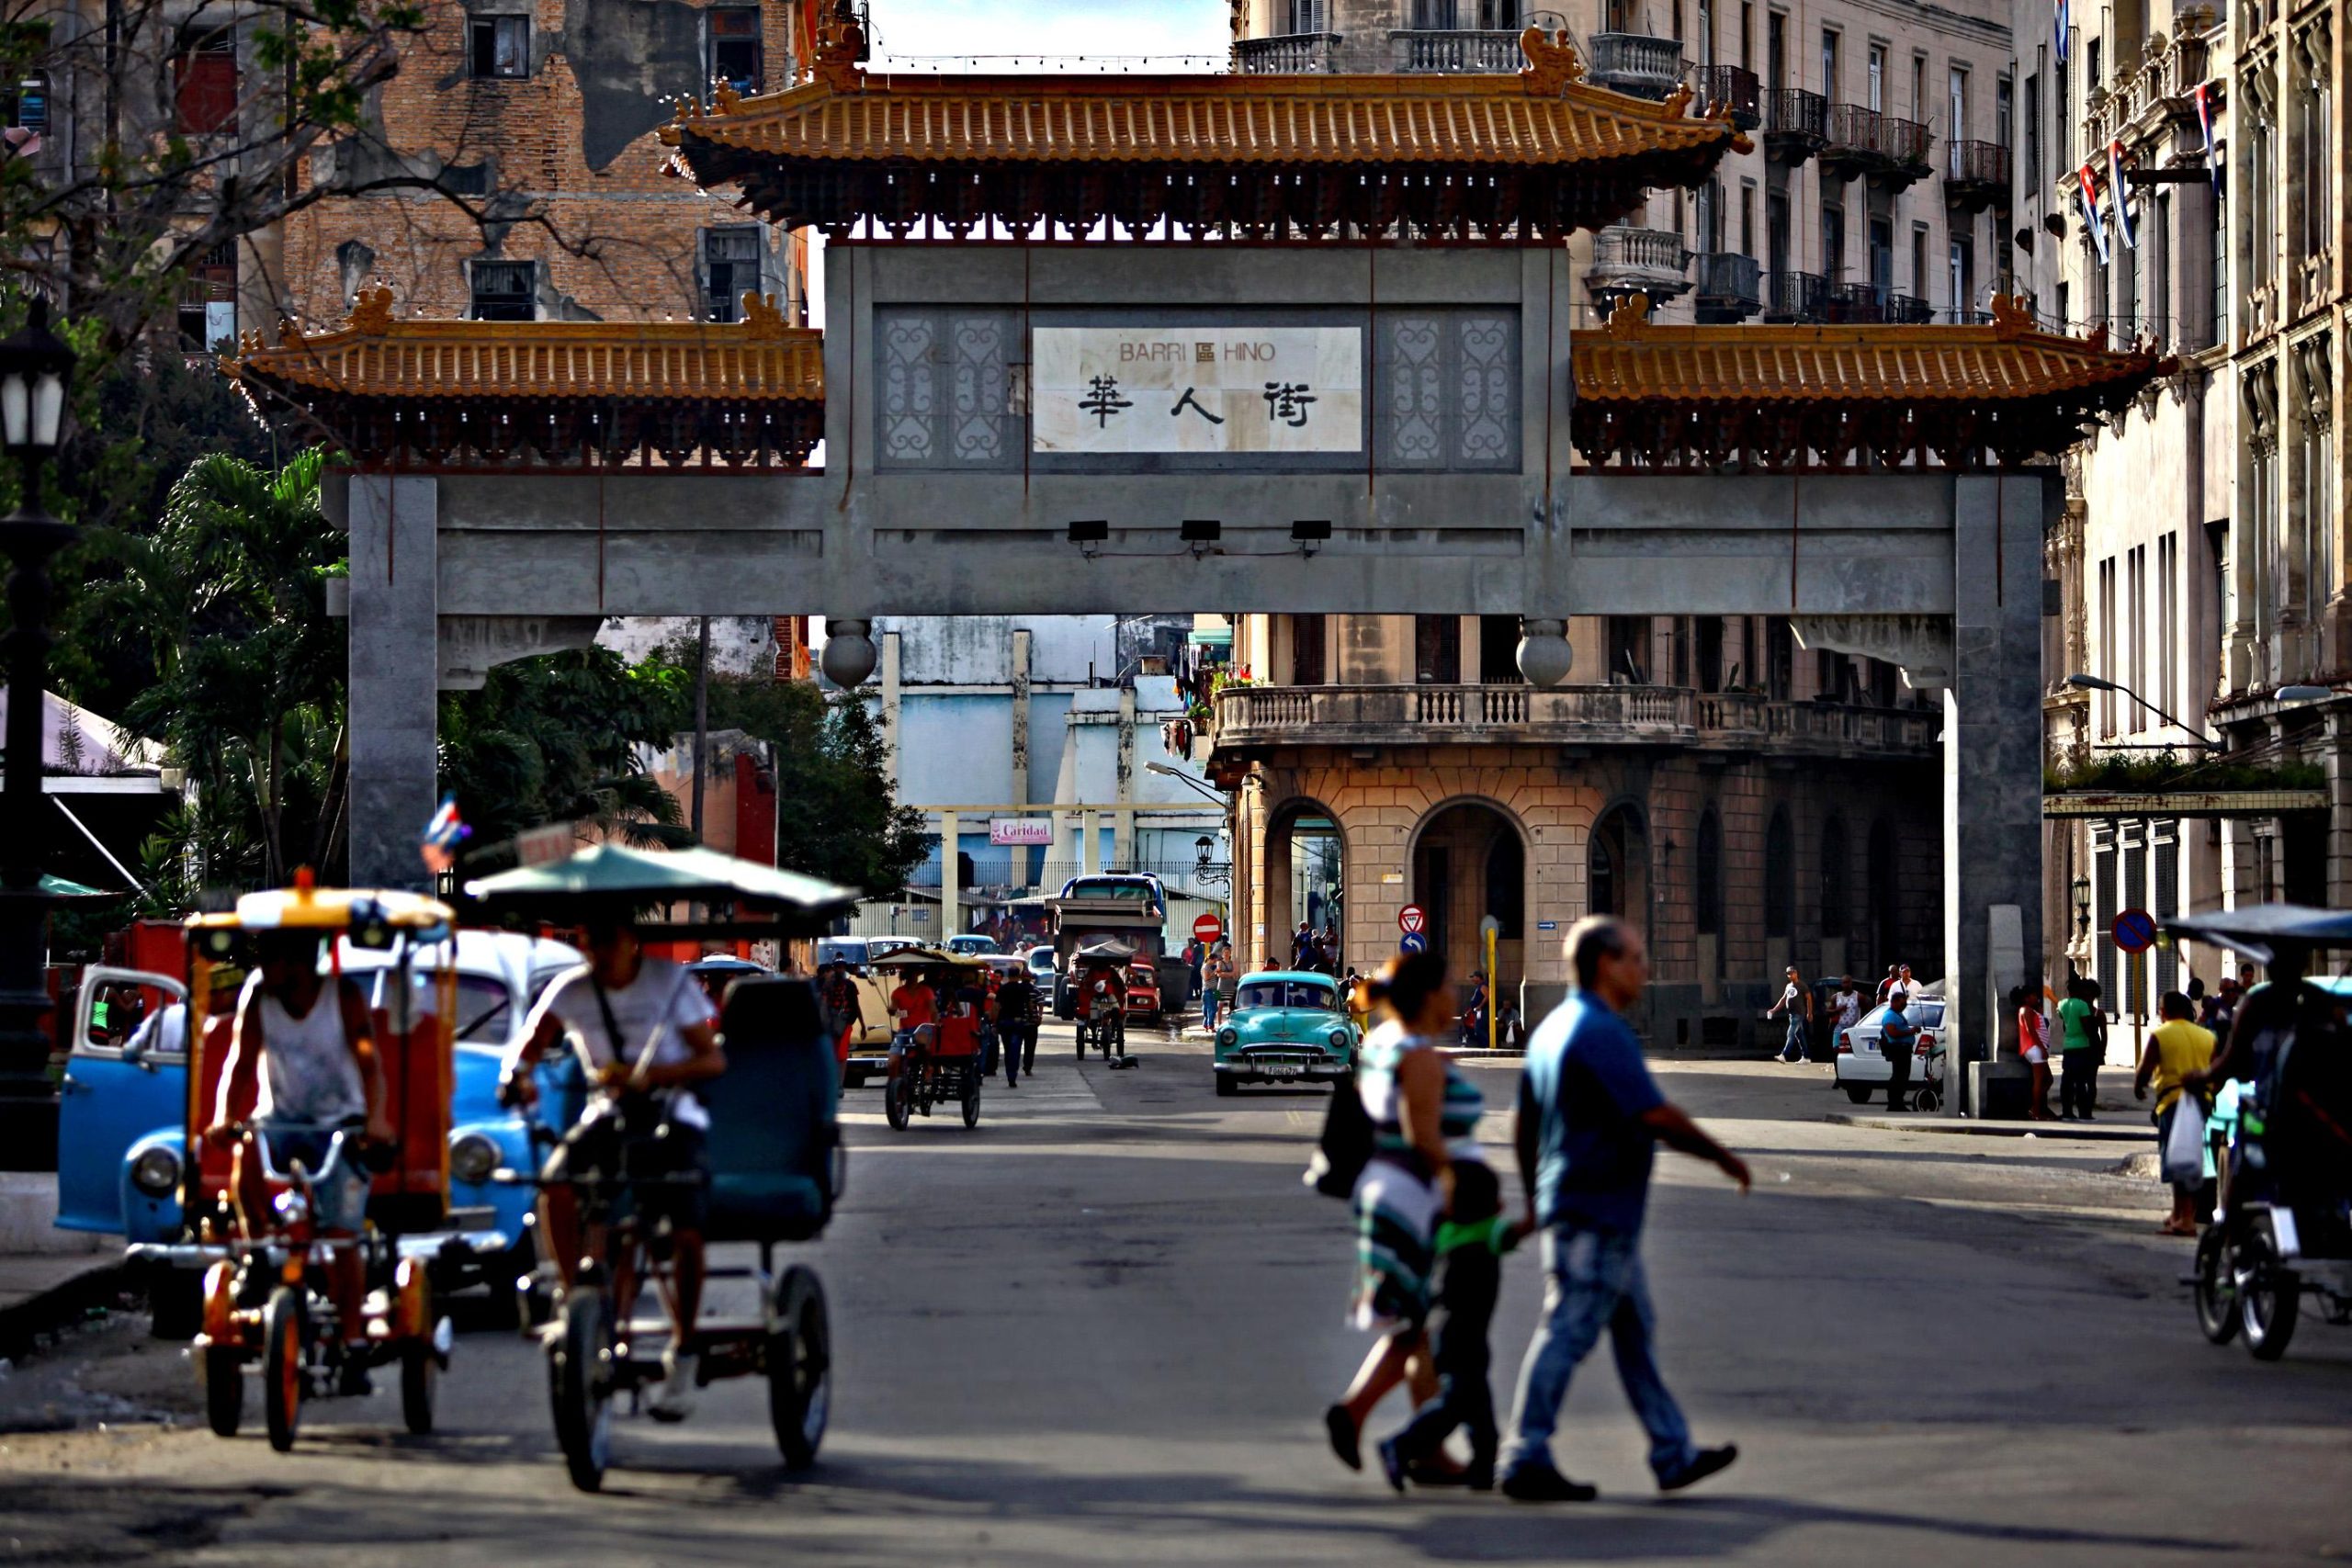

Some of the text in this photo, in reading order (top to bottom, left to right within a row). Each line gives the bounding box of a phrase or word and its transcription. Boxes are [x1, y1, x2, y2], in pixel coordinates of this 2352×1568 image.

[1120, 343, 1186, 361] BARRI
[1195, 342, 1215, 362] 區
[1224, 343, 1275, 361] HINO
[1078, 376, 1317, 428] 華人街
[1003, 823, 1047, 836] Caridad
